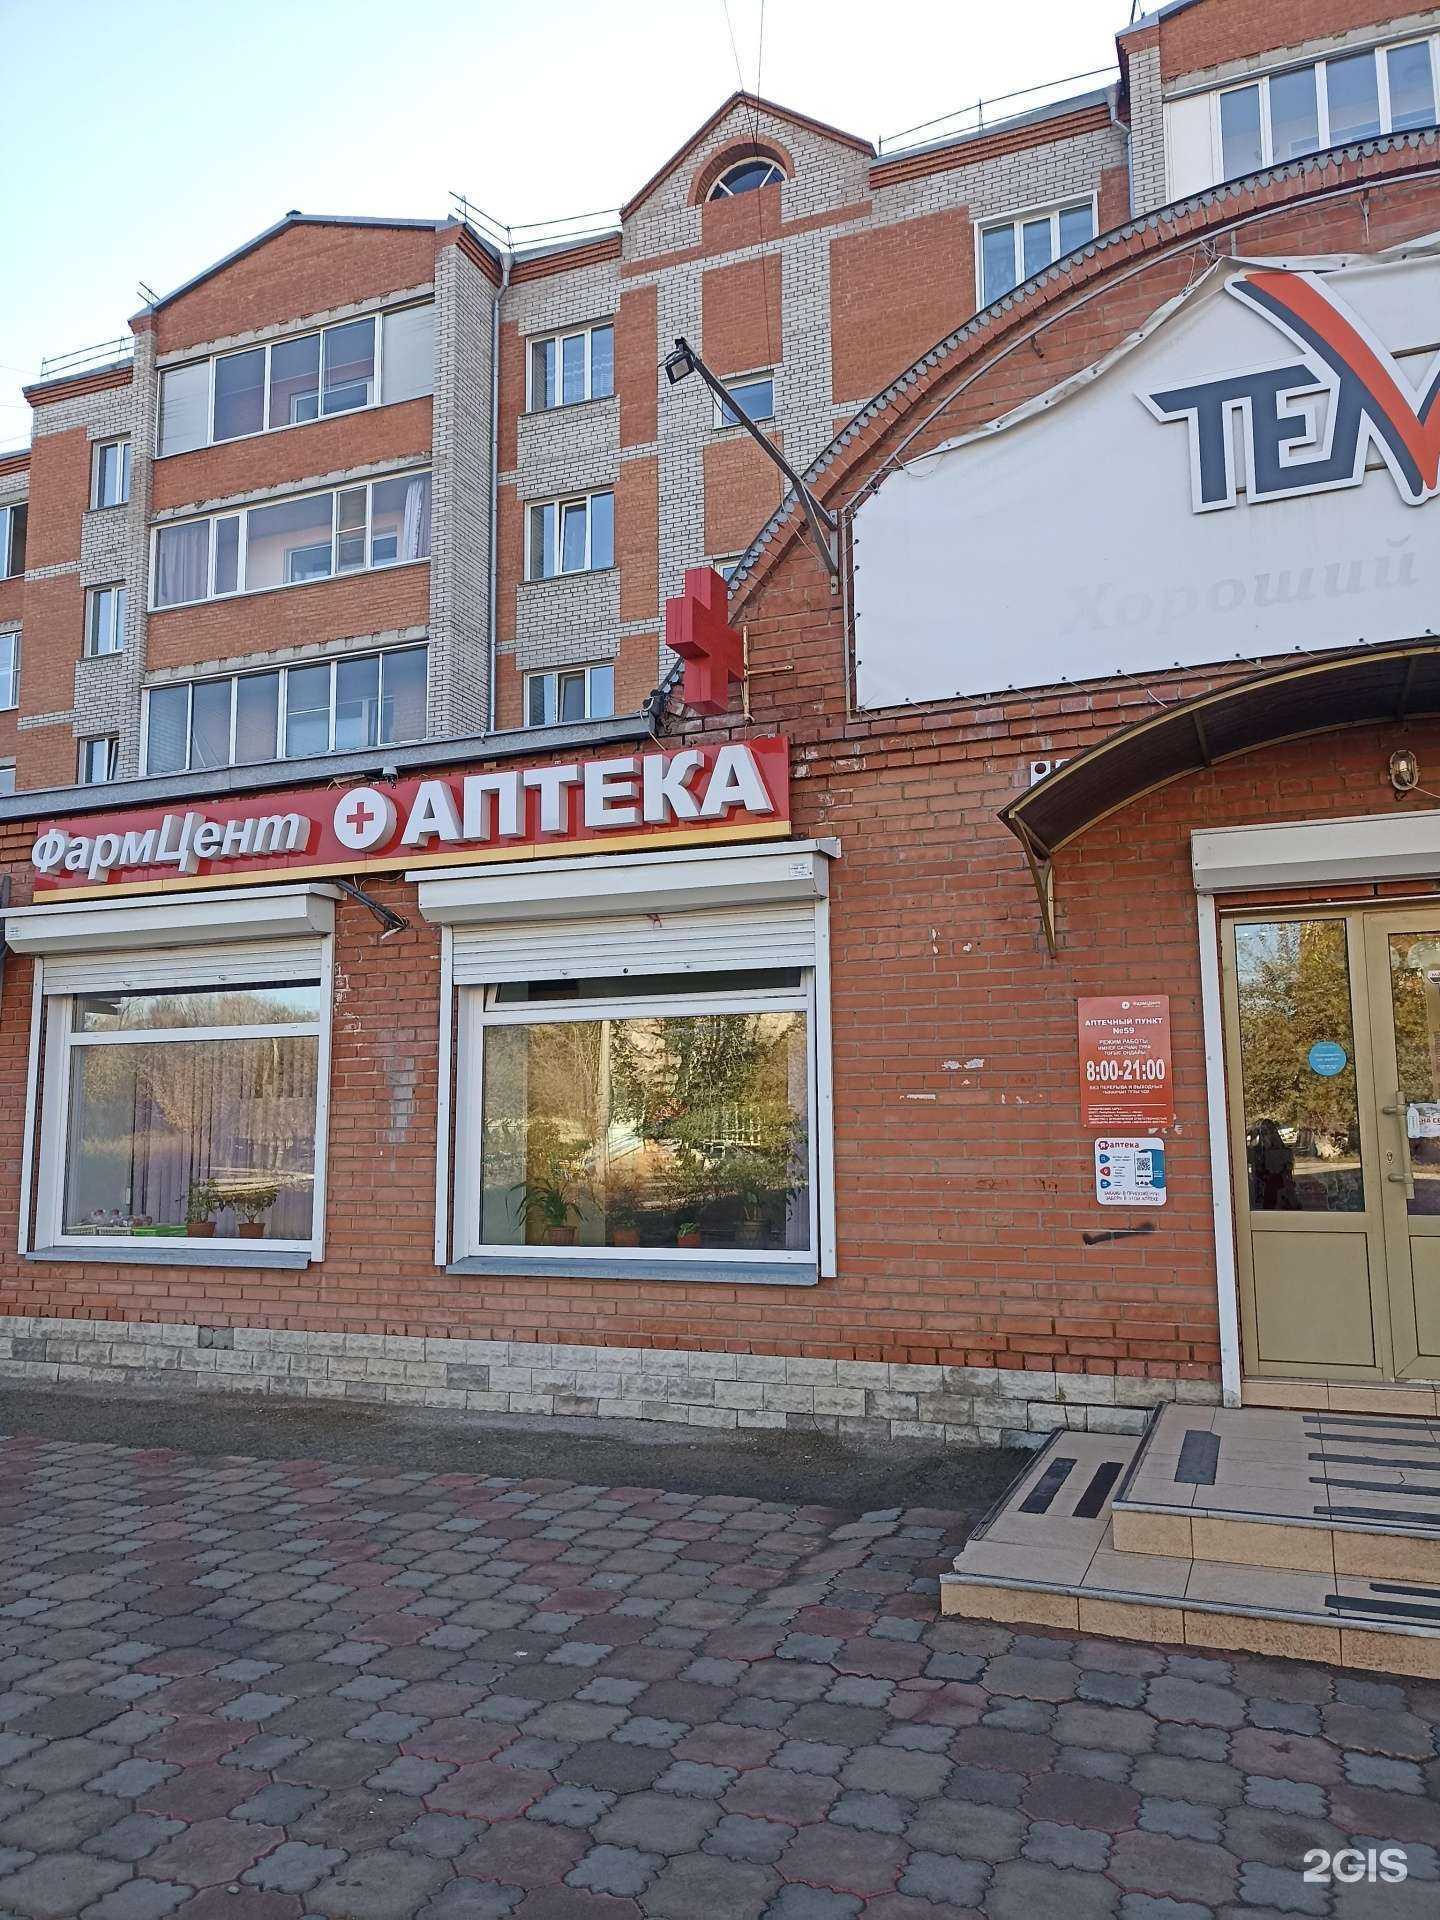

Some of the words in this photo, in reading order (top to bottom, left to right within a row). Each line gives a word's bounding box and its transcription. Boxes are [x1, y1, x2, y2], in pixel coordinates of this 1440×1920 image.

[31, 810, 311, 886] ФармЦент
[399, 743, 775, 848] АПТЕКА
[1085, 1018, 1133, 1026] АПТЕЧНЫЙ
[1135, 1017, 1163, 1025] ПУНКТ
[1086, 1059, 1166, 1081] 8:00-21:00
